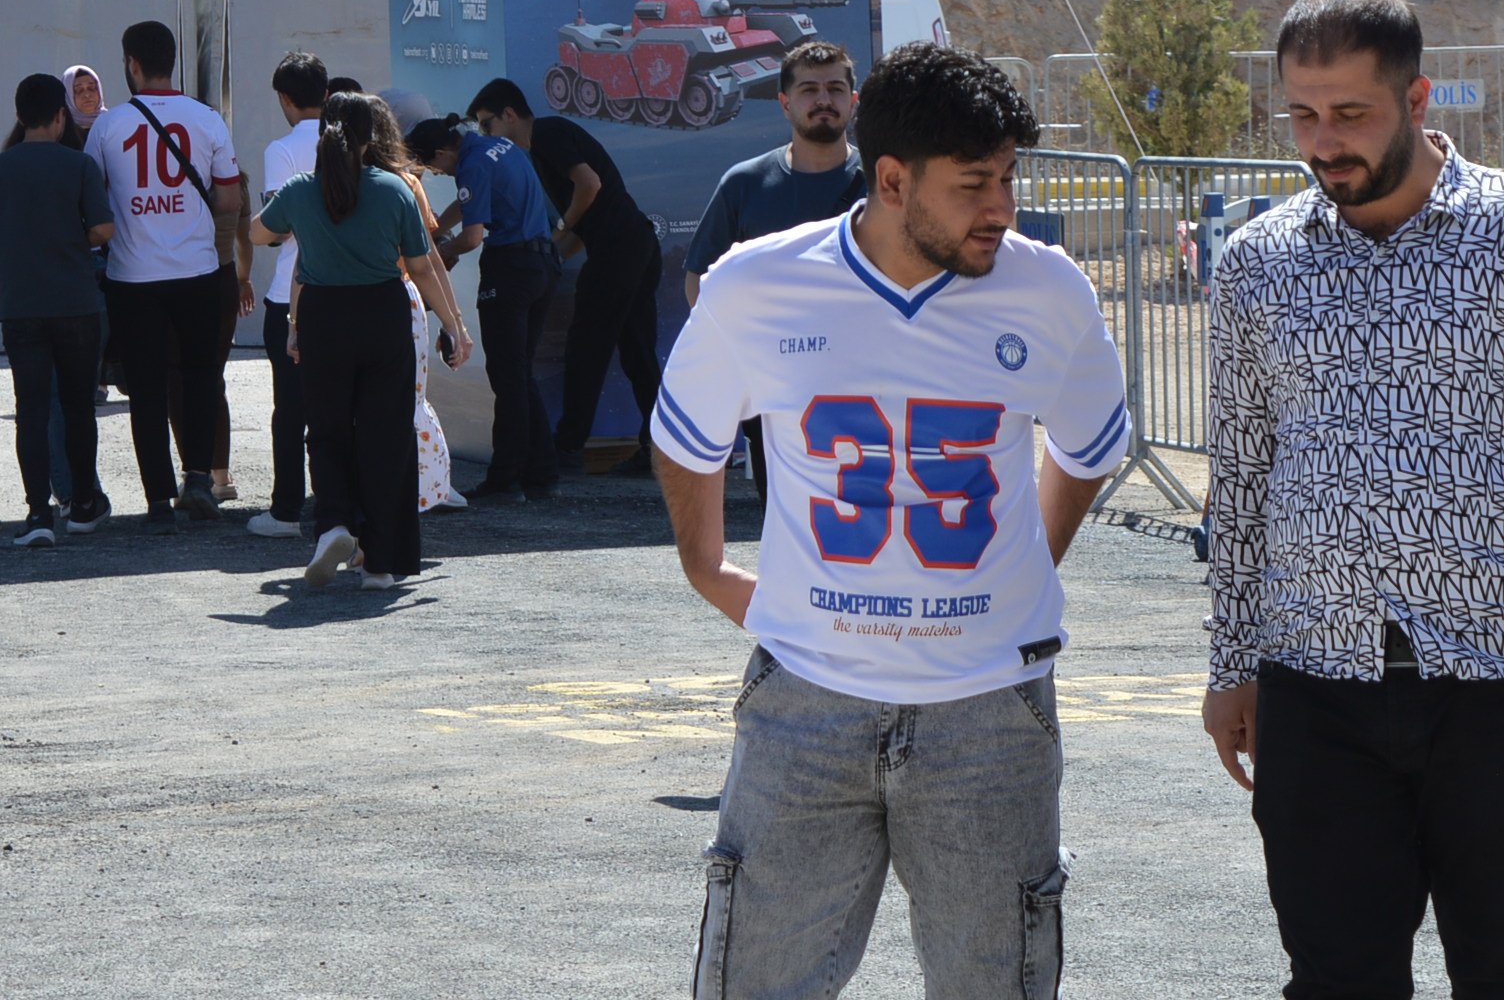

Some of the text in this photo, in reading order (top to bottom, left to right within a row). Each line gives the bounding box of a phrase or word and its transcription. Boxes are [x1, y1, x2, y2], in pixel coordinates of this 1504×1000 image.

[123, 122, 191, 188] 10
[131, 189, 185, 215] SANÉ
[779, 336, 831, 354] CHAMP.
[800, 395, 1006, 570] 35
[810, 586, 992, 619] CHAMPIONS LEAGUE
[833, 617, 962, 642] the varsity matches
